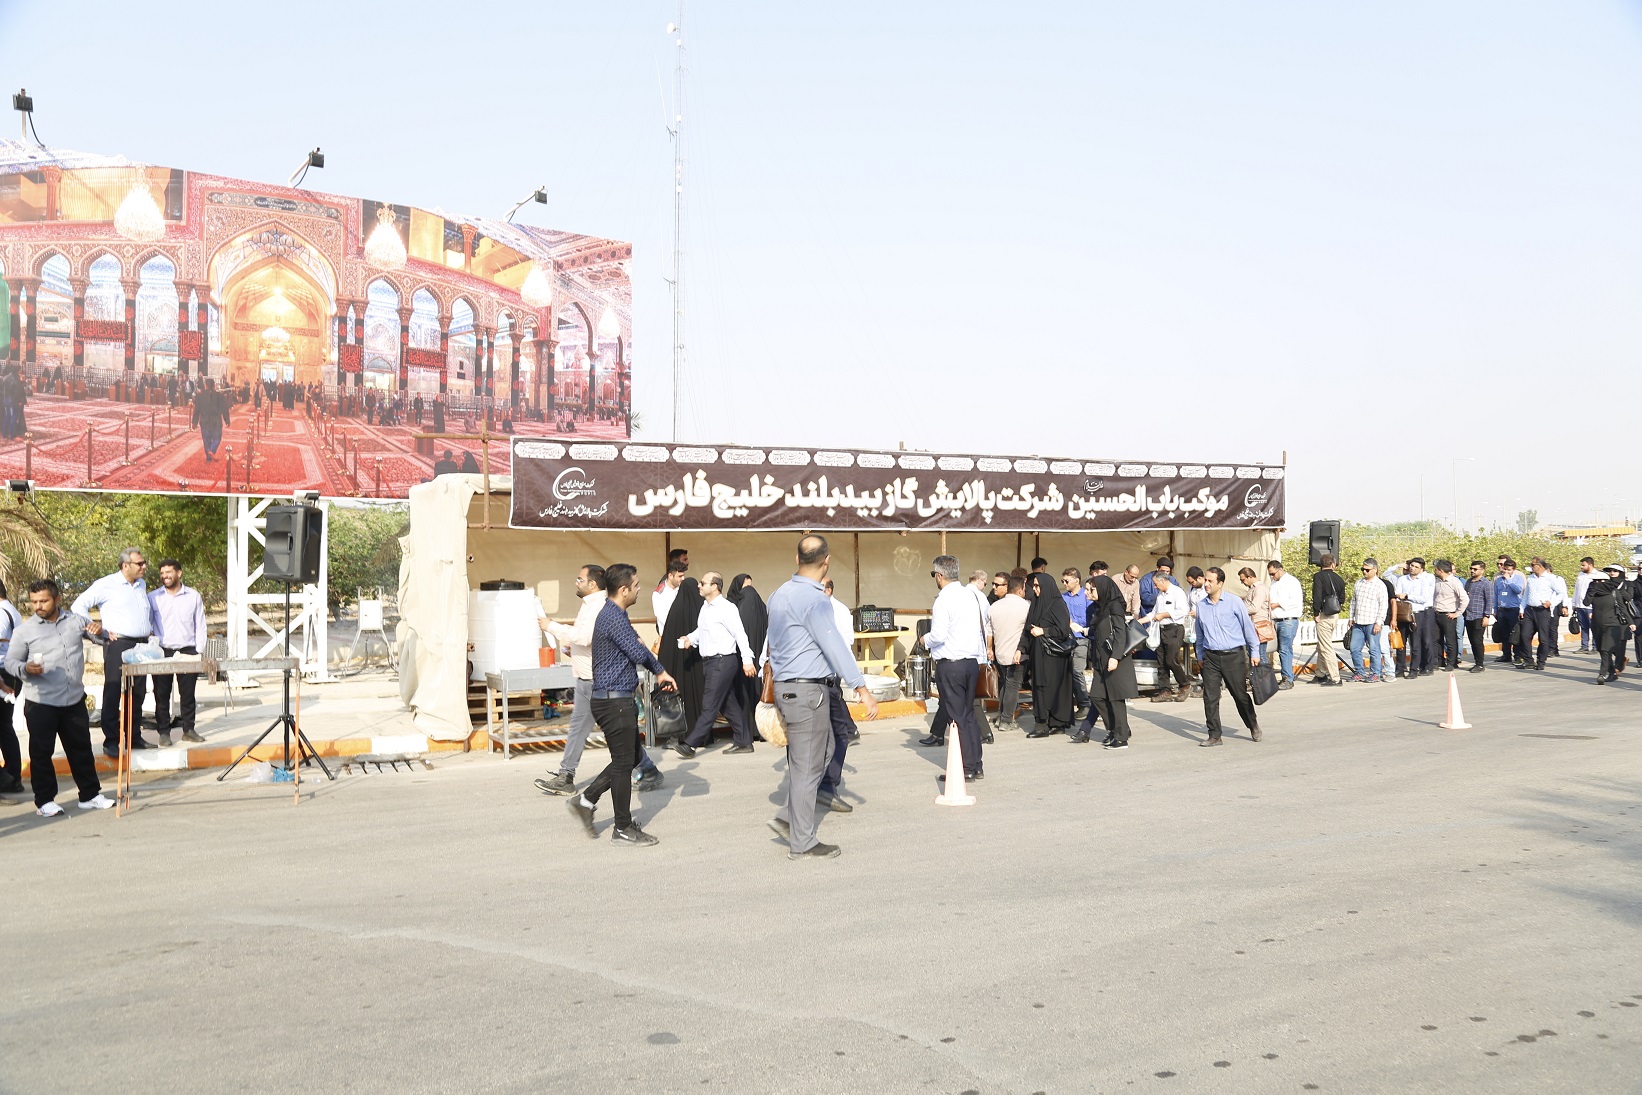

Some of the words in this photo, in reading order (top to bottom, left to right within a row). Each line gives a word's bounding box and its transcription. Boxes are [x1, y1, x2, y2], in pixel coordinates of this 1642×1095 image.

[628, 468, 711, 516] فارس
[711, 473, 785, 518] خلیج
[881, 477, 918, 517] گاز
[916, 479, 996, 524] پالایش
[995, 482, 1064, 519] شرکت
[1067, 484, 1146, 520] الحسین
[1146, 486, 1178, 519] باب
[1178, 487, 1229, 518] موکب
